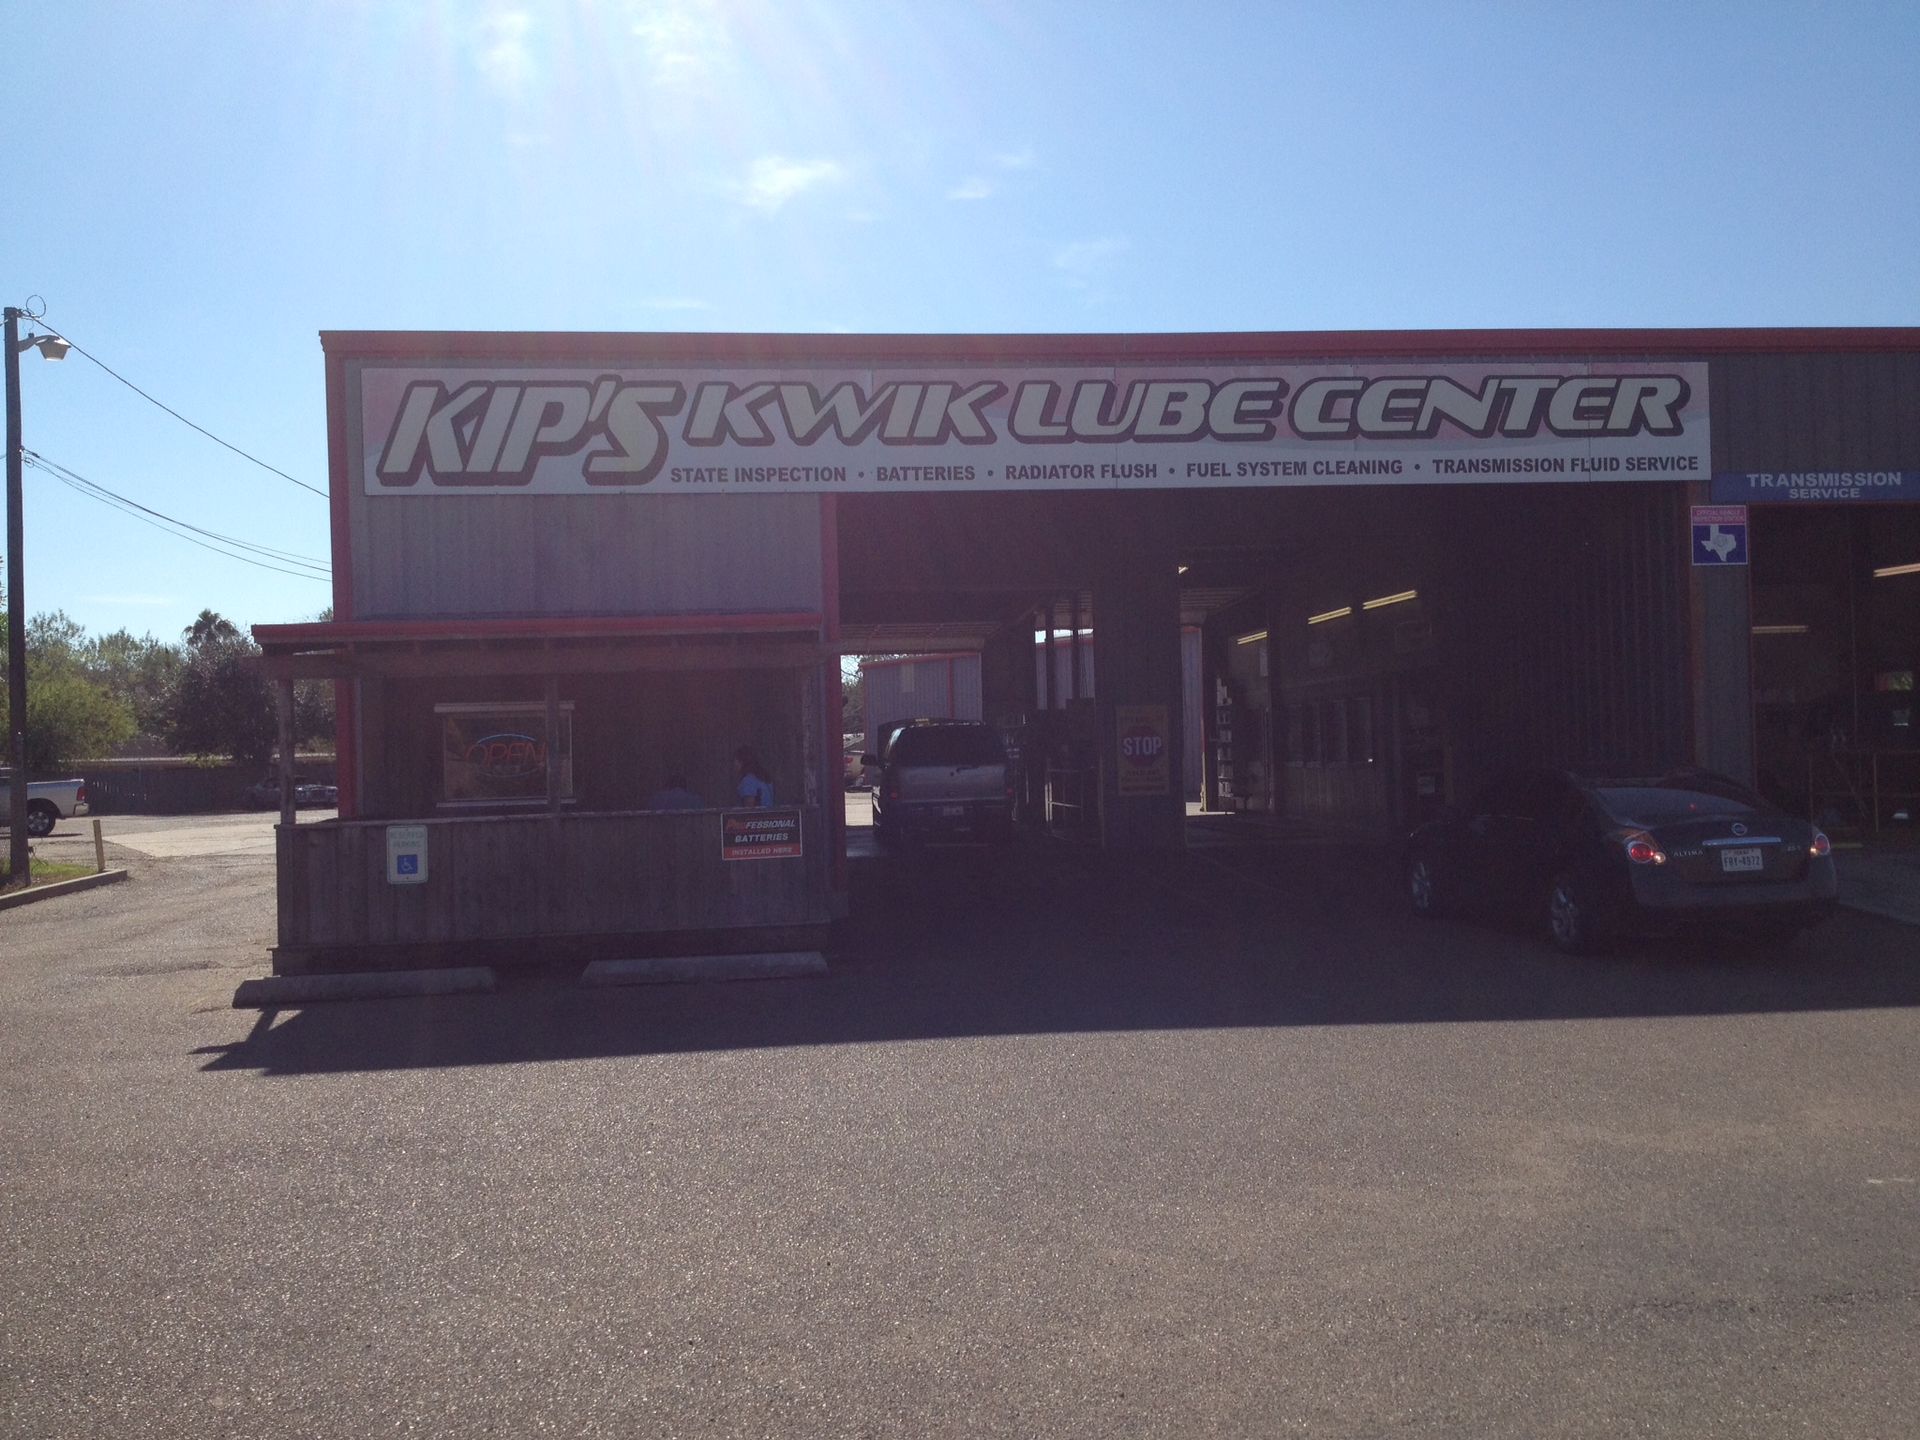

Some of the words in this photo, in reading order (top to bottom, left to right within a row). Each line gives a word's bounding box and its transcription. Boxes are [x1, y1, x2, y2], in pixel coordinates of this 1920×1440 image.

[376, 374, 687, 487] KIP'S
[680, 380, 1008, 446] KWIK
[1007, 377, 1290, 444] LUBE
[1286, 374, 1691, 441] CENTER
[670, 467, 728, 483] STATE
[734, 466, 847, 483] INSPECTION
[876, 465, 976, 482] BATTERIES
[1004, 464, 1095, 481] RADIATOR
[1100, 463, 1158, 479] FLUSH
[1186, 462, 1232, 478] FUEL
[1236, 461, 1307, 477] SYSTEM
[1312, 459, 1403, 476] CLEANING
[1432, 458, 1566, 474] TRANSMISSION
[1570, 457, 1621, 473] FLUID
[1625, 456, 1699, 472] SERVICE
[1746, 471, 1902, 488] TRANSMISSION
[1788, 487, 1861, 500] SERVICE
[1123, 736, 1162, 756] STOP
[735, 832, 789, 843] BATTERIES
